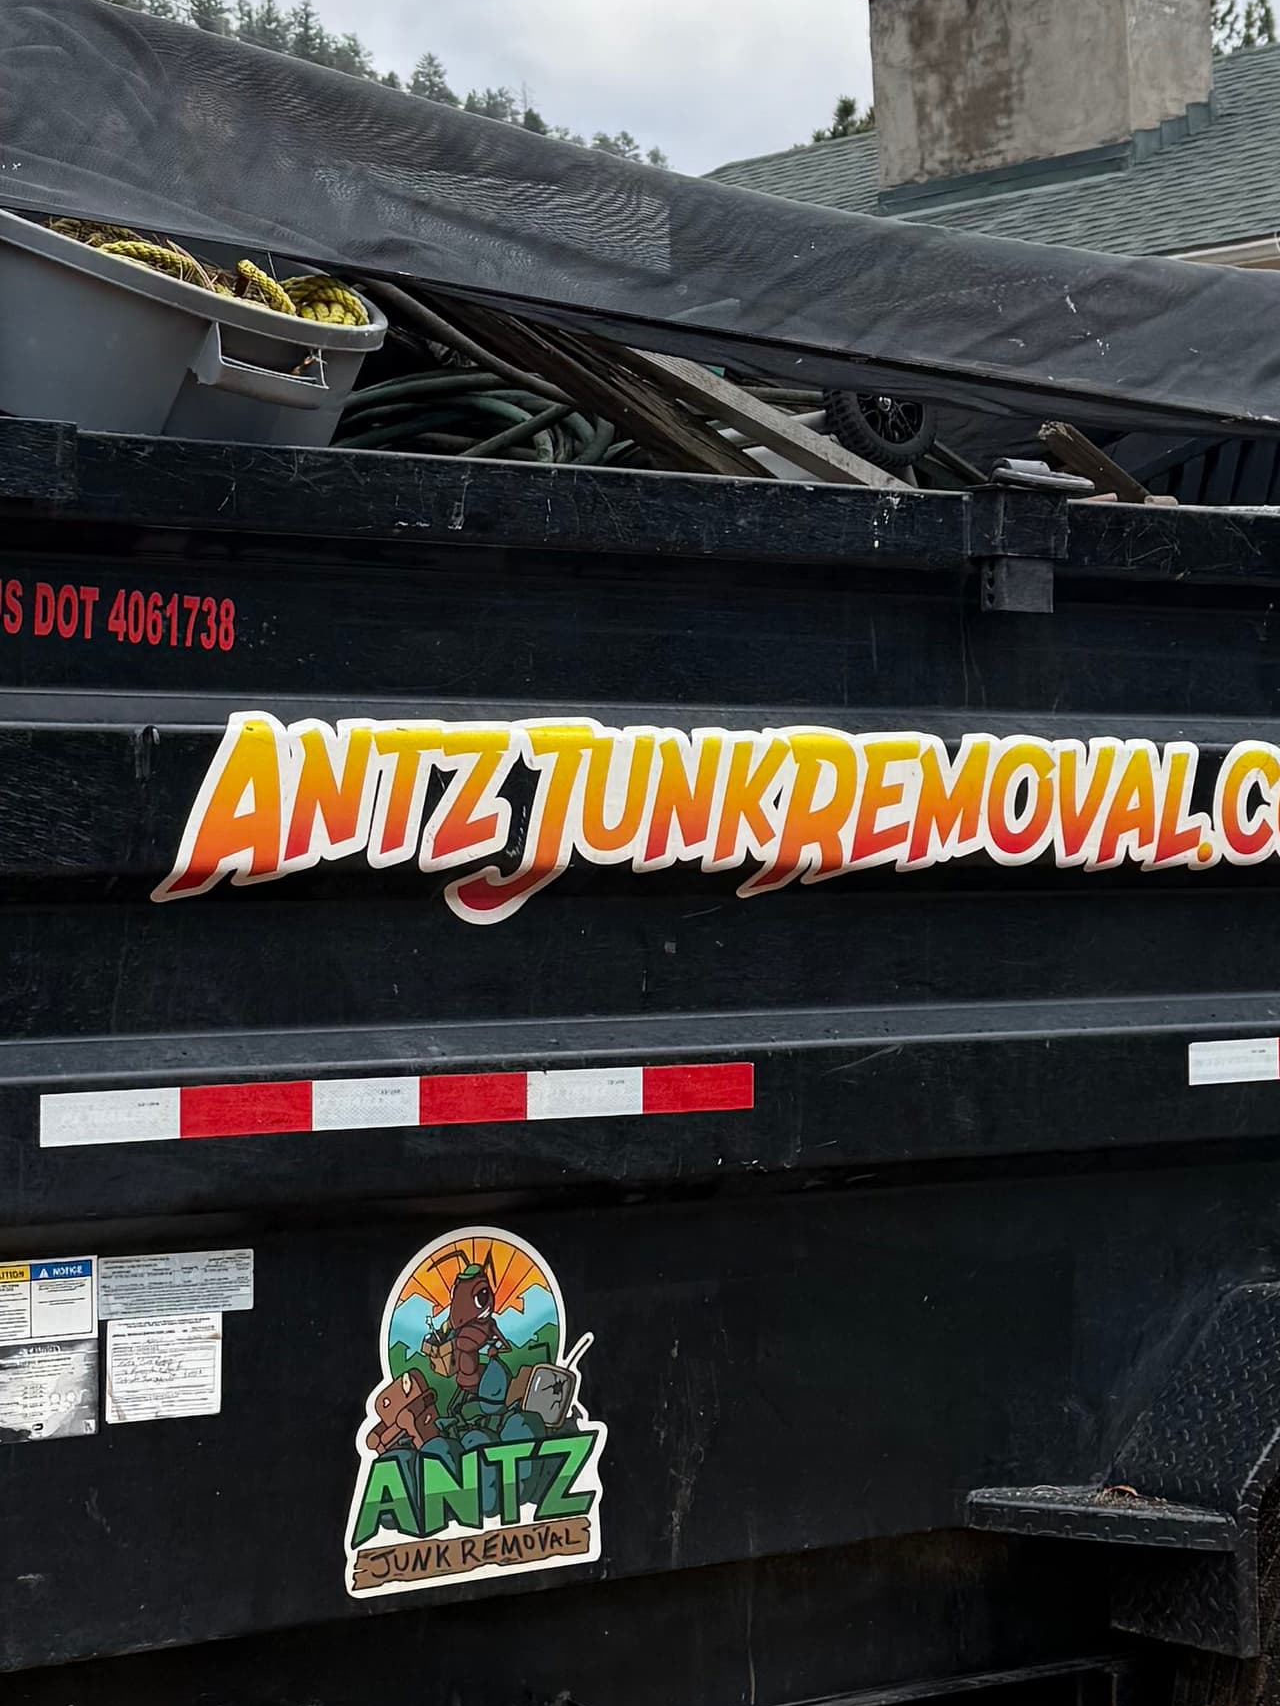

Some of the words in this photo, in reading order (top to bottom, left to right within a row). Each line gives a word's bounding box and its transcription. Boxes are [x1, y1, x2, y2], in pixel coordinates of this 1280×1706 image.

[34, 582, 99, 639] DOT
[108, 588, 236, 651] 4061738
[52, 1264, 83, 1277] NOTICE
[351, 1430, 598, 1549] ANTZ
[371, 1544, 451, 1578] JUNK
[462, 1523, 582, 1561] REMOVAL
